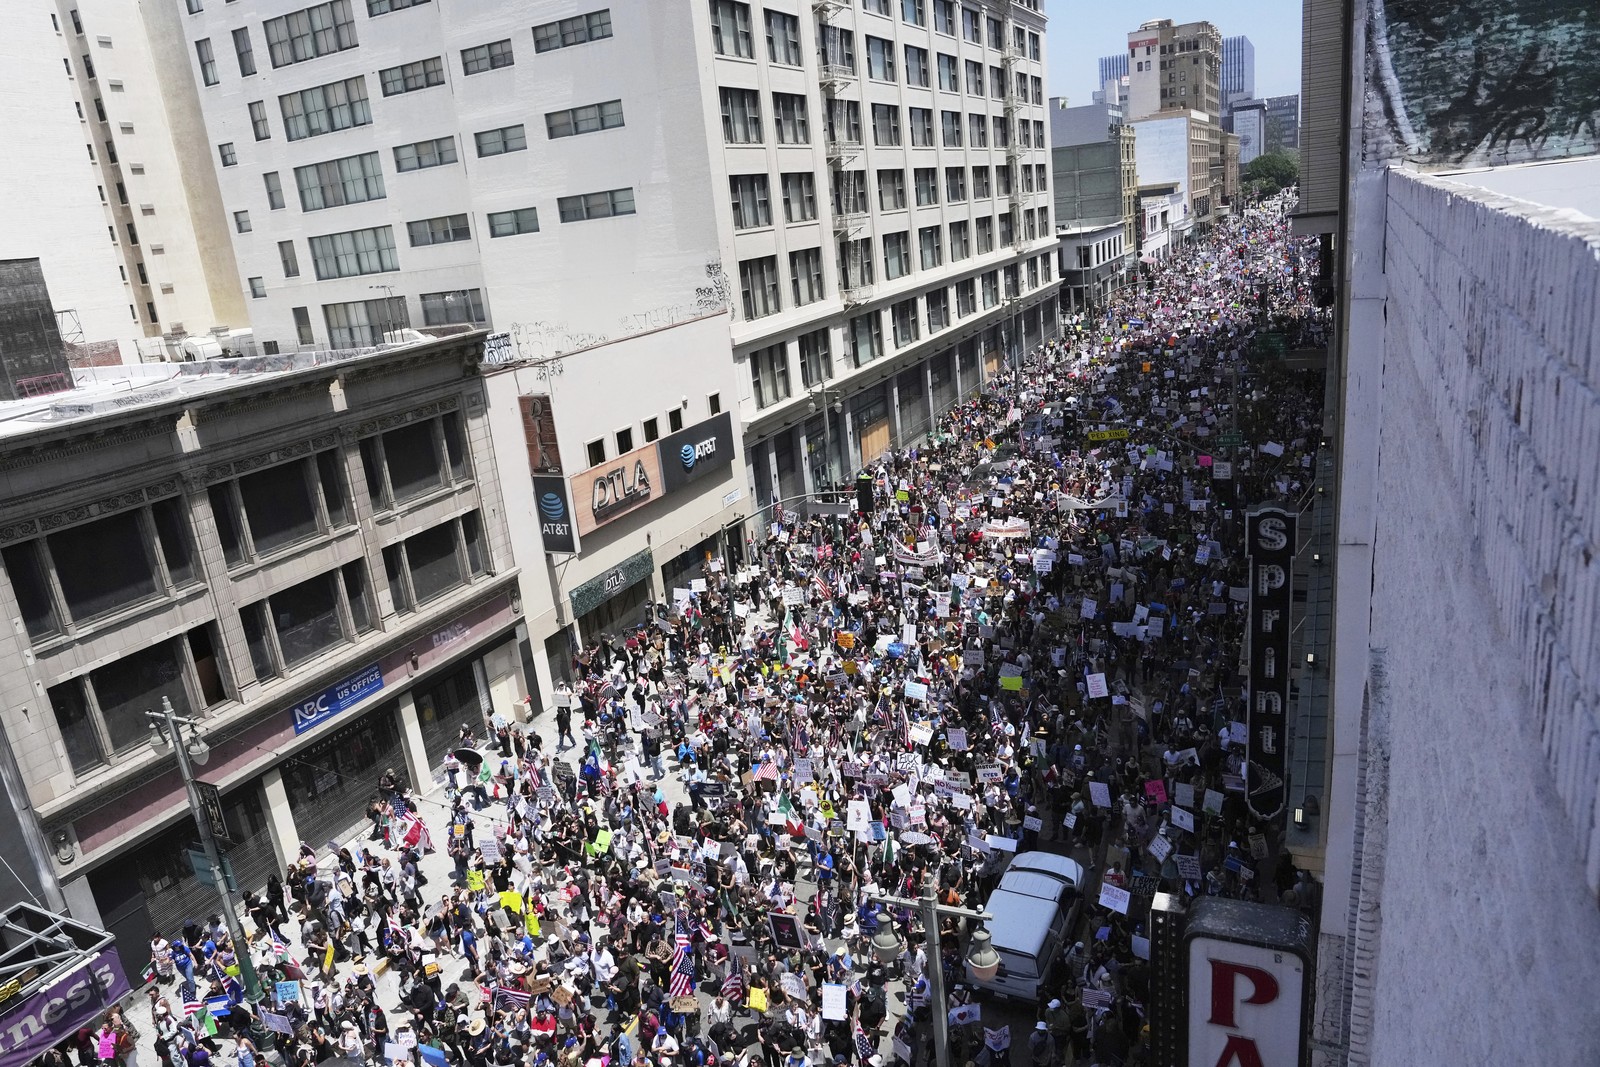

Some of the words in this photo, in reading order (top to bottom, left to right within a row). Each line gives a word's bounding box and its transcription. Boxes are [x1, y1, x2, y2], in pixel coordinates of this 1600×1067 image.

[694, 436, 717, 459] AT&T
[592, 459, 649, 510] DTLA
[542, 523, 569, 536] AT&T
[605, 571, 625, 592] DTLA
[1256, 518, 1288, 755] Sprint
[337, 688, 350, 700] US
[351, 670, 381, 692] OFFICE
